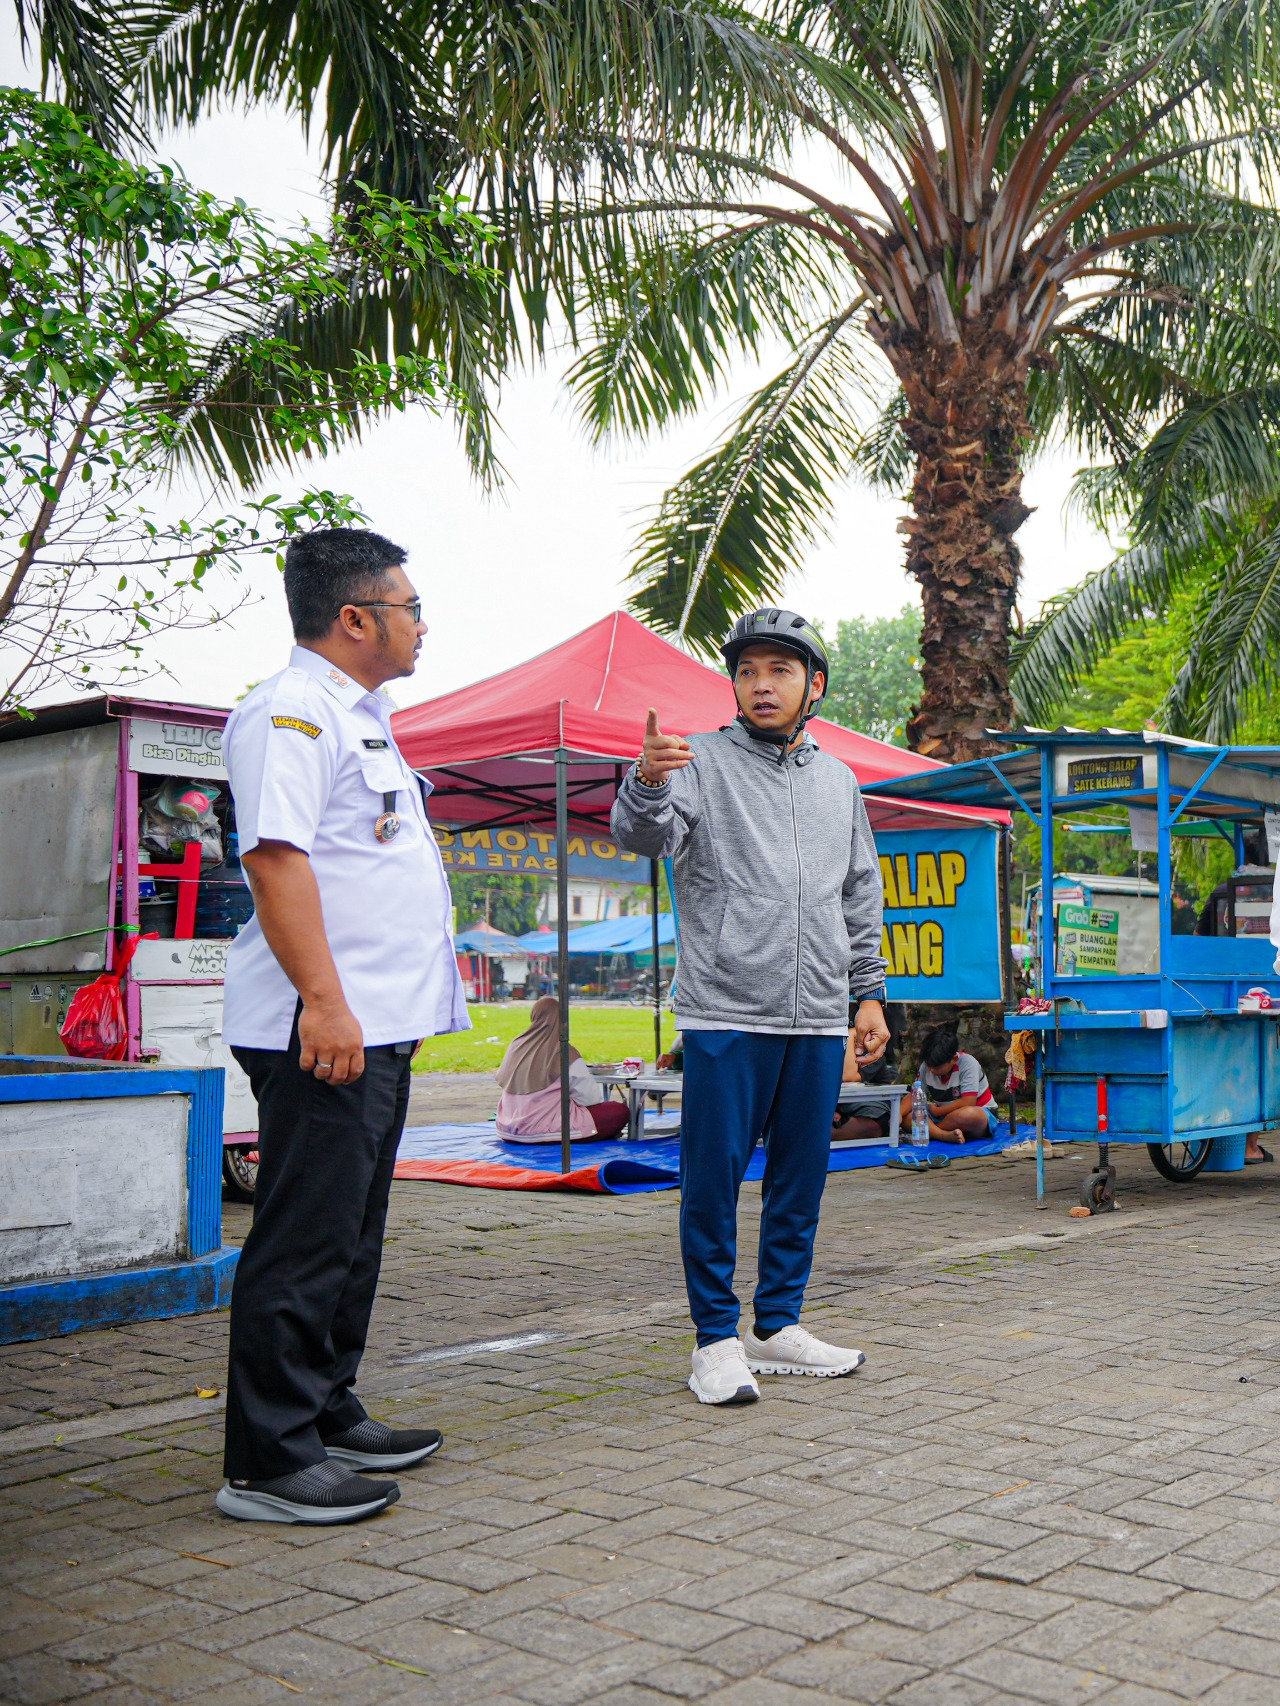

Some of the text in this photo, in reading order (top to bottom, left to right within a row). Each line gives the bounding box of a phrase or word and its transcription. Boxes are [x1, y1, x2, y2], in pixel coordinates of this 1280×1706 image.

[162, 723, 223, 750] TEH G
[143, 744, 173, 760] Bisa
[176, 748, 220, 766] Dingin
[1068, 759, 1138, 776] LONTONG BALAP
[1074, 775, 1131, 791] SATE KERANG
[878, 850, 967, 910] ALAP
[1065, 908, 1089, 925] Grab
[1080, 934, 1117, 946] BUANGLAH
[188, 943, 231, 960] MIC
[1079, 945, 1117, 956] SAMPAH PADA
[190, 958, 228, 973] MO
[1080, 955, 1117, 967] TEMPATNYA
